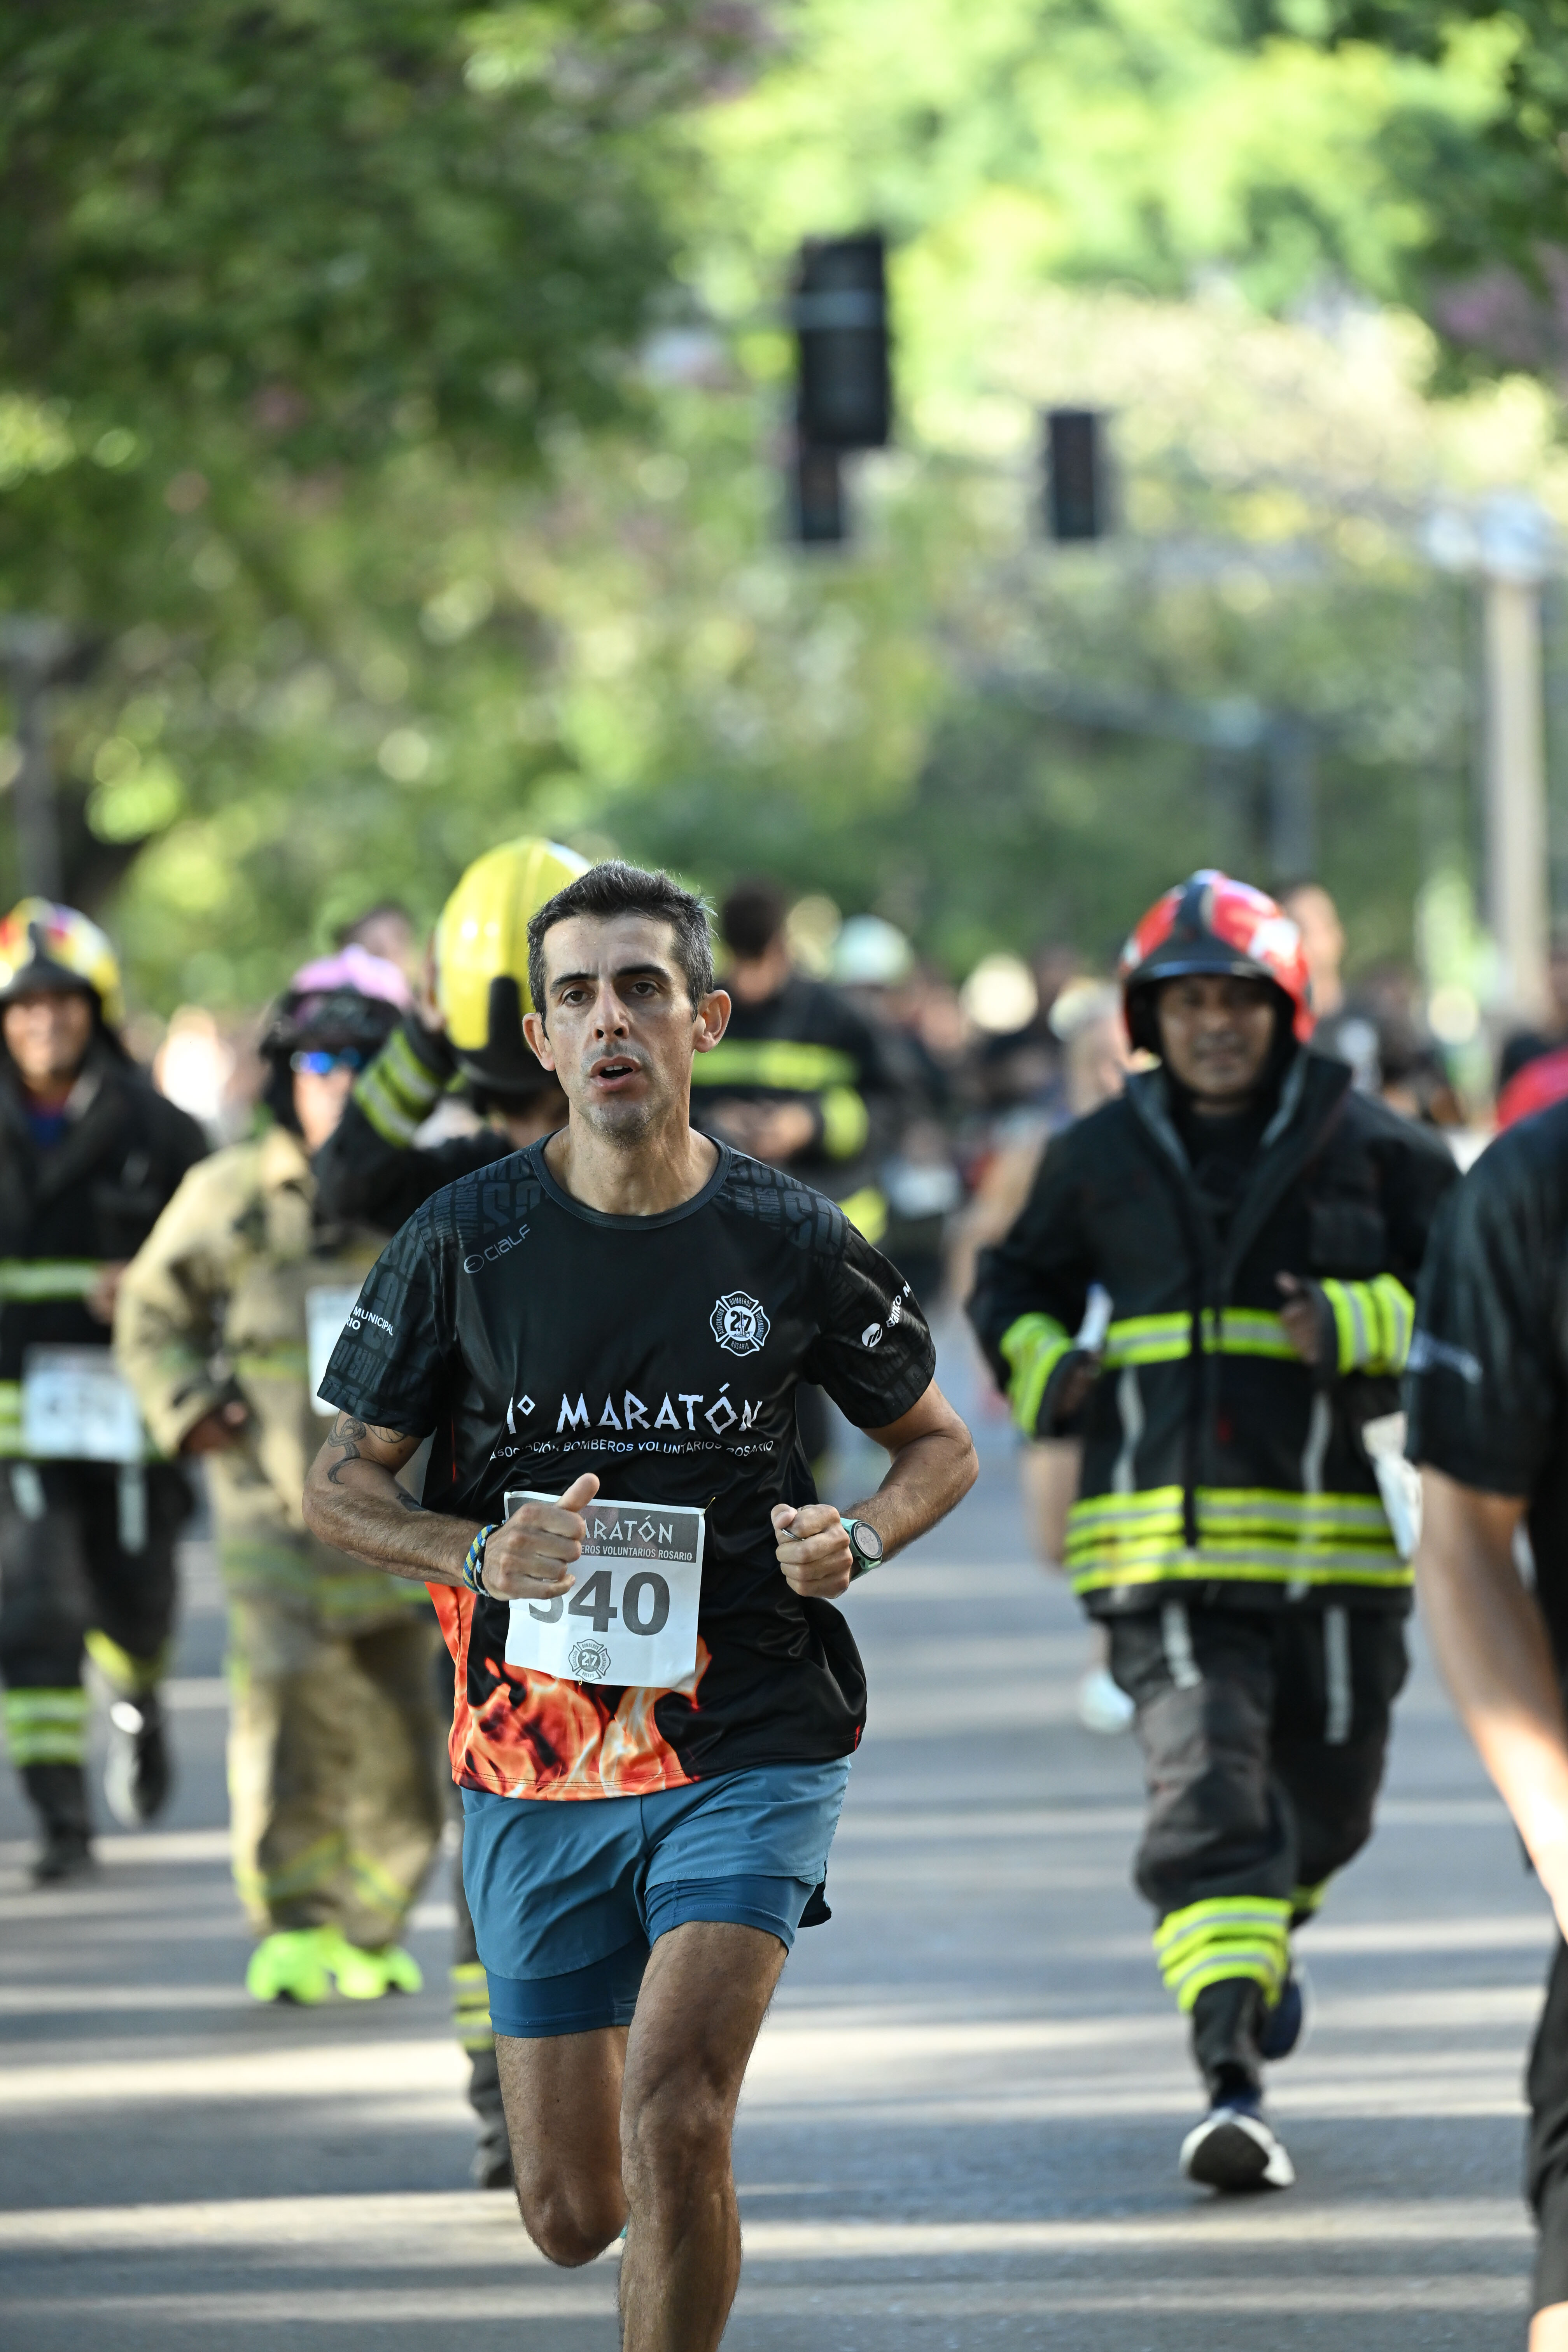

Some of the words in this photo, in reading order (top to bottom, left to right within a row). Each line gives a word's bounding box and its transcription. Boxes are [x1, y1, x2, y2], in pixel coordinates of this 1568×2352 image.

[729, 1297, 752, 1308] BOMBEROS
[886, 1295, 901, 1328] Banco
[353, 1306, 393, 1336] MUNICIPAL
[730, 1310, 752, 1332] 27
[730, 1341, 749, 1350] ROSARIO
[556, 1382, 763, 1435] MARATÓN
[490, 1441, 560, 1461] ASOCACIÓN
[564, 1439, 634, 1452] BOMBEROS
[603, 1545, 656, 1558] VOLUNTARIOS
[658, 1549, 693, 1561] ROSARIO
[582, 1652, 598, 1666] 27
